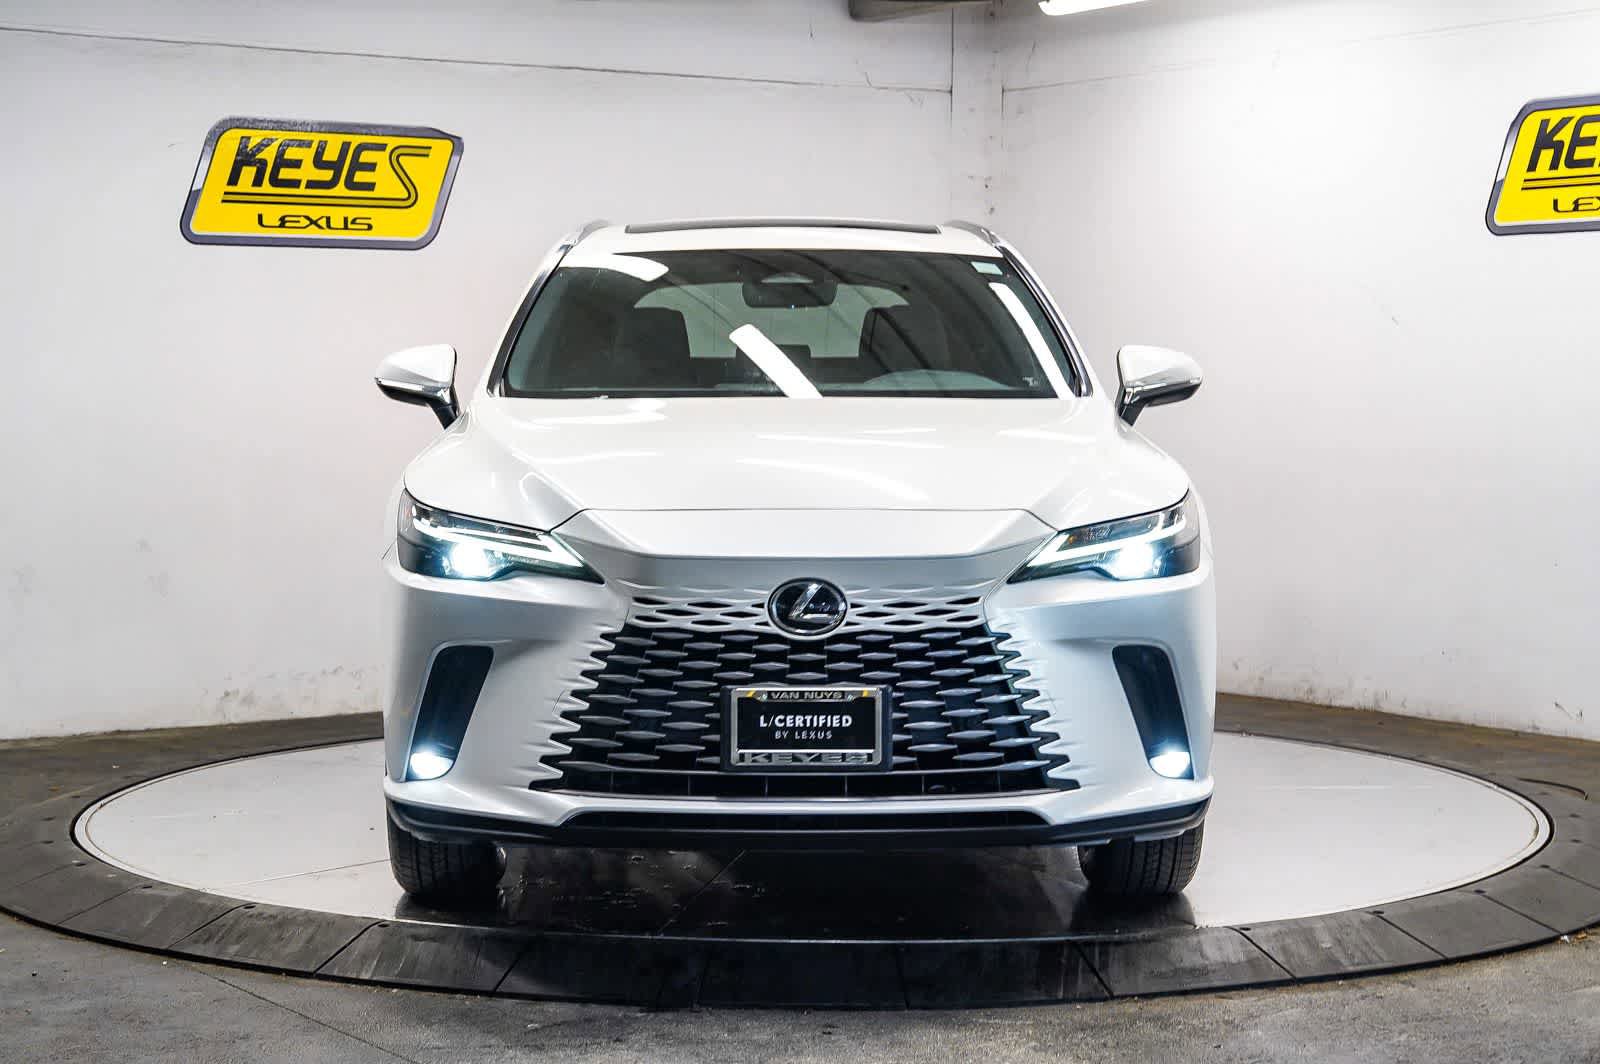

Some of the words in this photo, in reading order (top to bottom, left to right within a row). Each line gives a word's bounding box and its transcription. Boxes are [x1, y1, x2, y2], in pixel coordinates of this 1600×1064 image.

[1526, 114, 1600, 172] KE
[222, 135, 432, 209] KEYES
[1553, 196, 1600, 213] LE
[257, 213, 373, 231] LEXUS
[770, 691, 800, 700] VAN
[803, 691, 843, 699] NUYS
[759, 714, 853, 728] L/CERTIFIED
[775, 730, 789, 739] BY
[794, 730, 833, 739] LEXUS
[744, 752, 868, 764] KEYES
